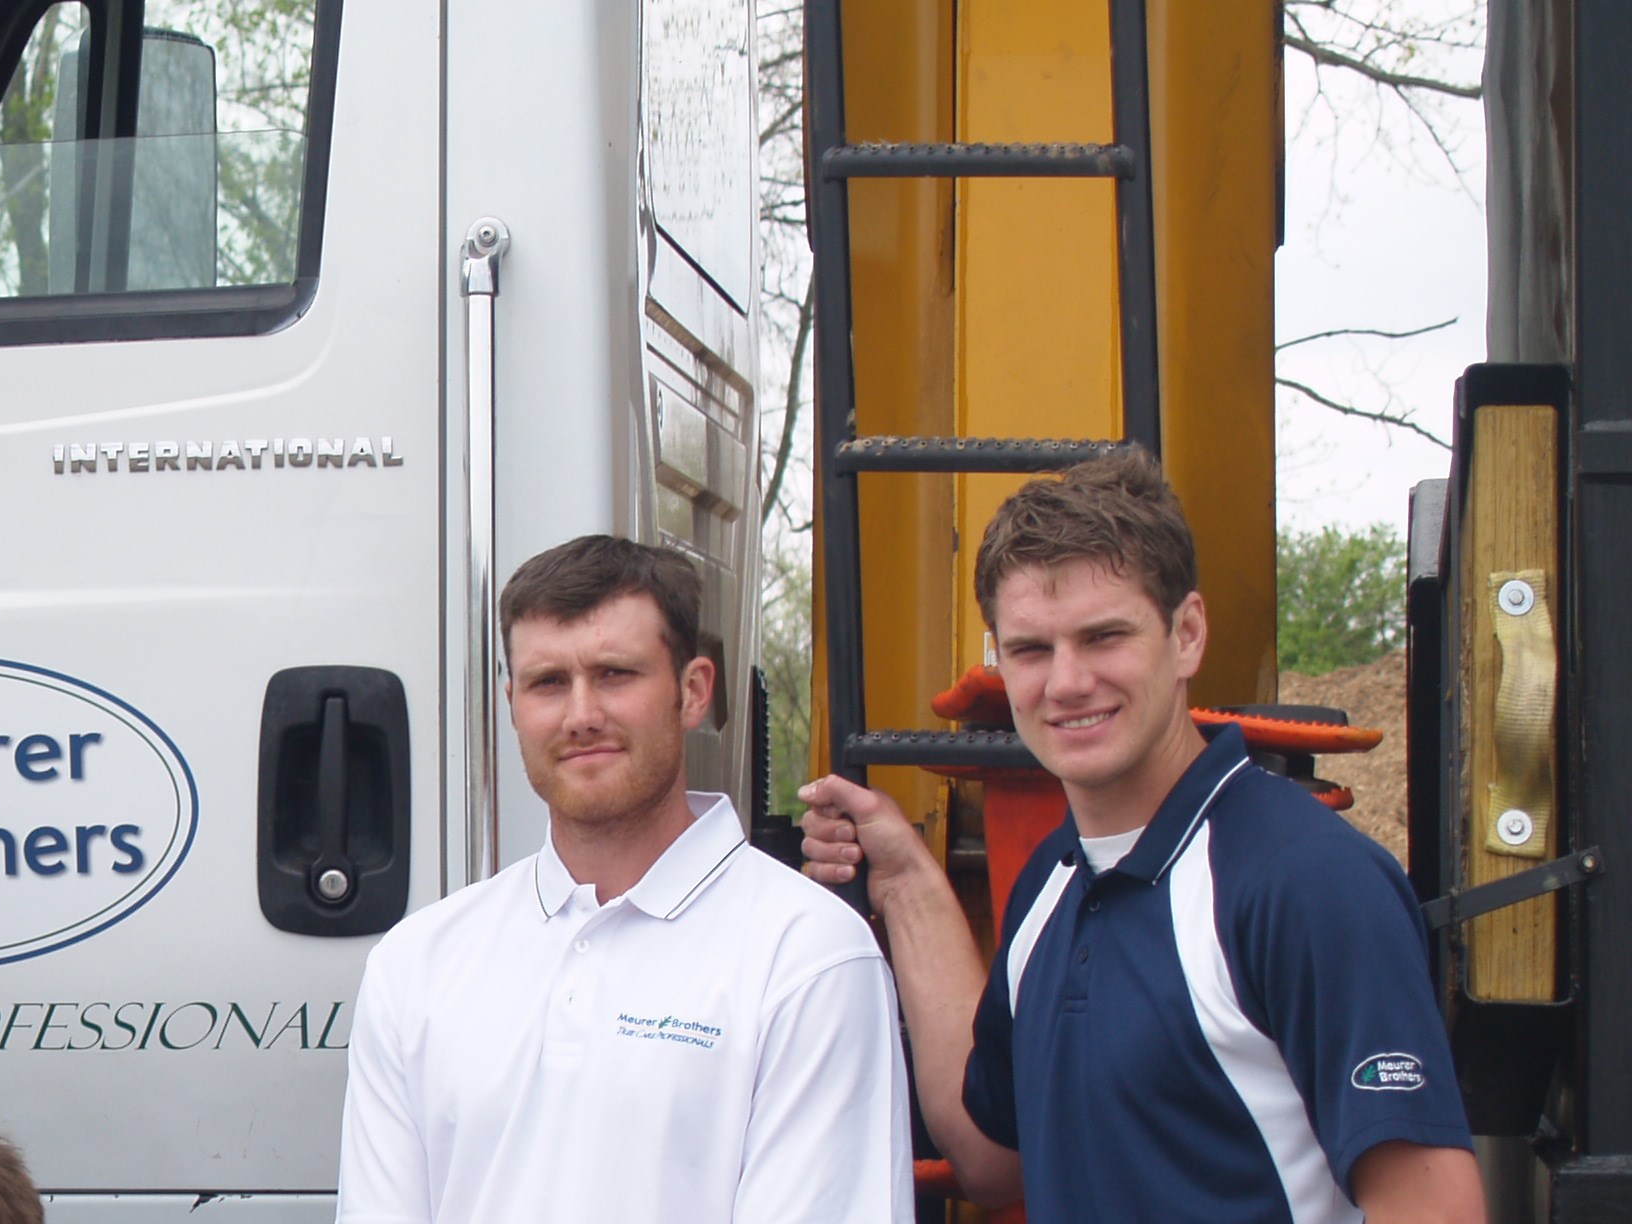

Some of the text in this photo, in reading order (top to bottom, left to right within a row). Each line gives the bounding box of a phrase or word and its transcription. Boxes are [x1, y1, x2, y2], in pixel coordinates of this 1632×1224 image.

[52, 436, 404, 475] INTERNATIONAL
[617, 1012, 722, 1037] Meurer Brothers
[1377, 1060, 1416, 1072] Meurer
